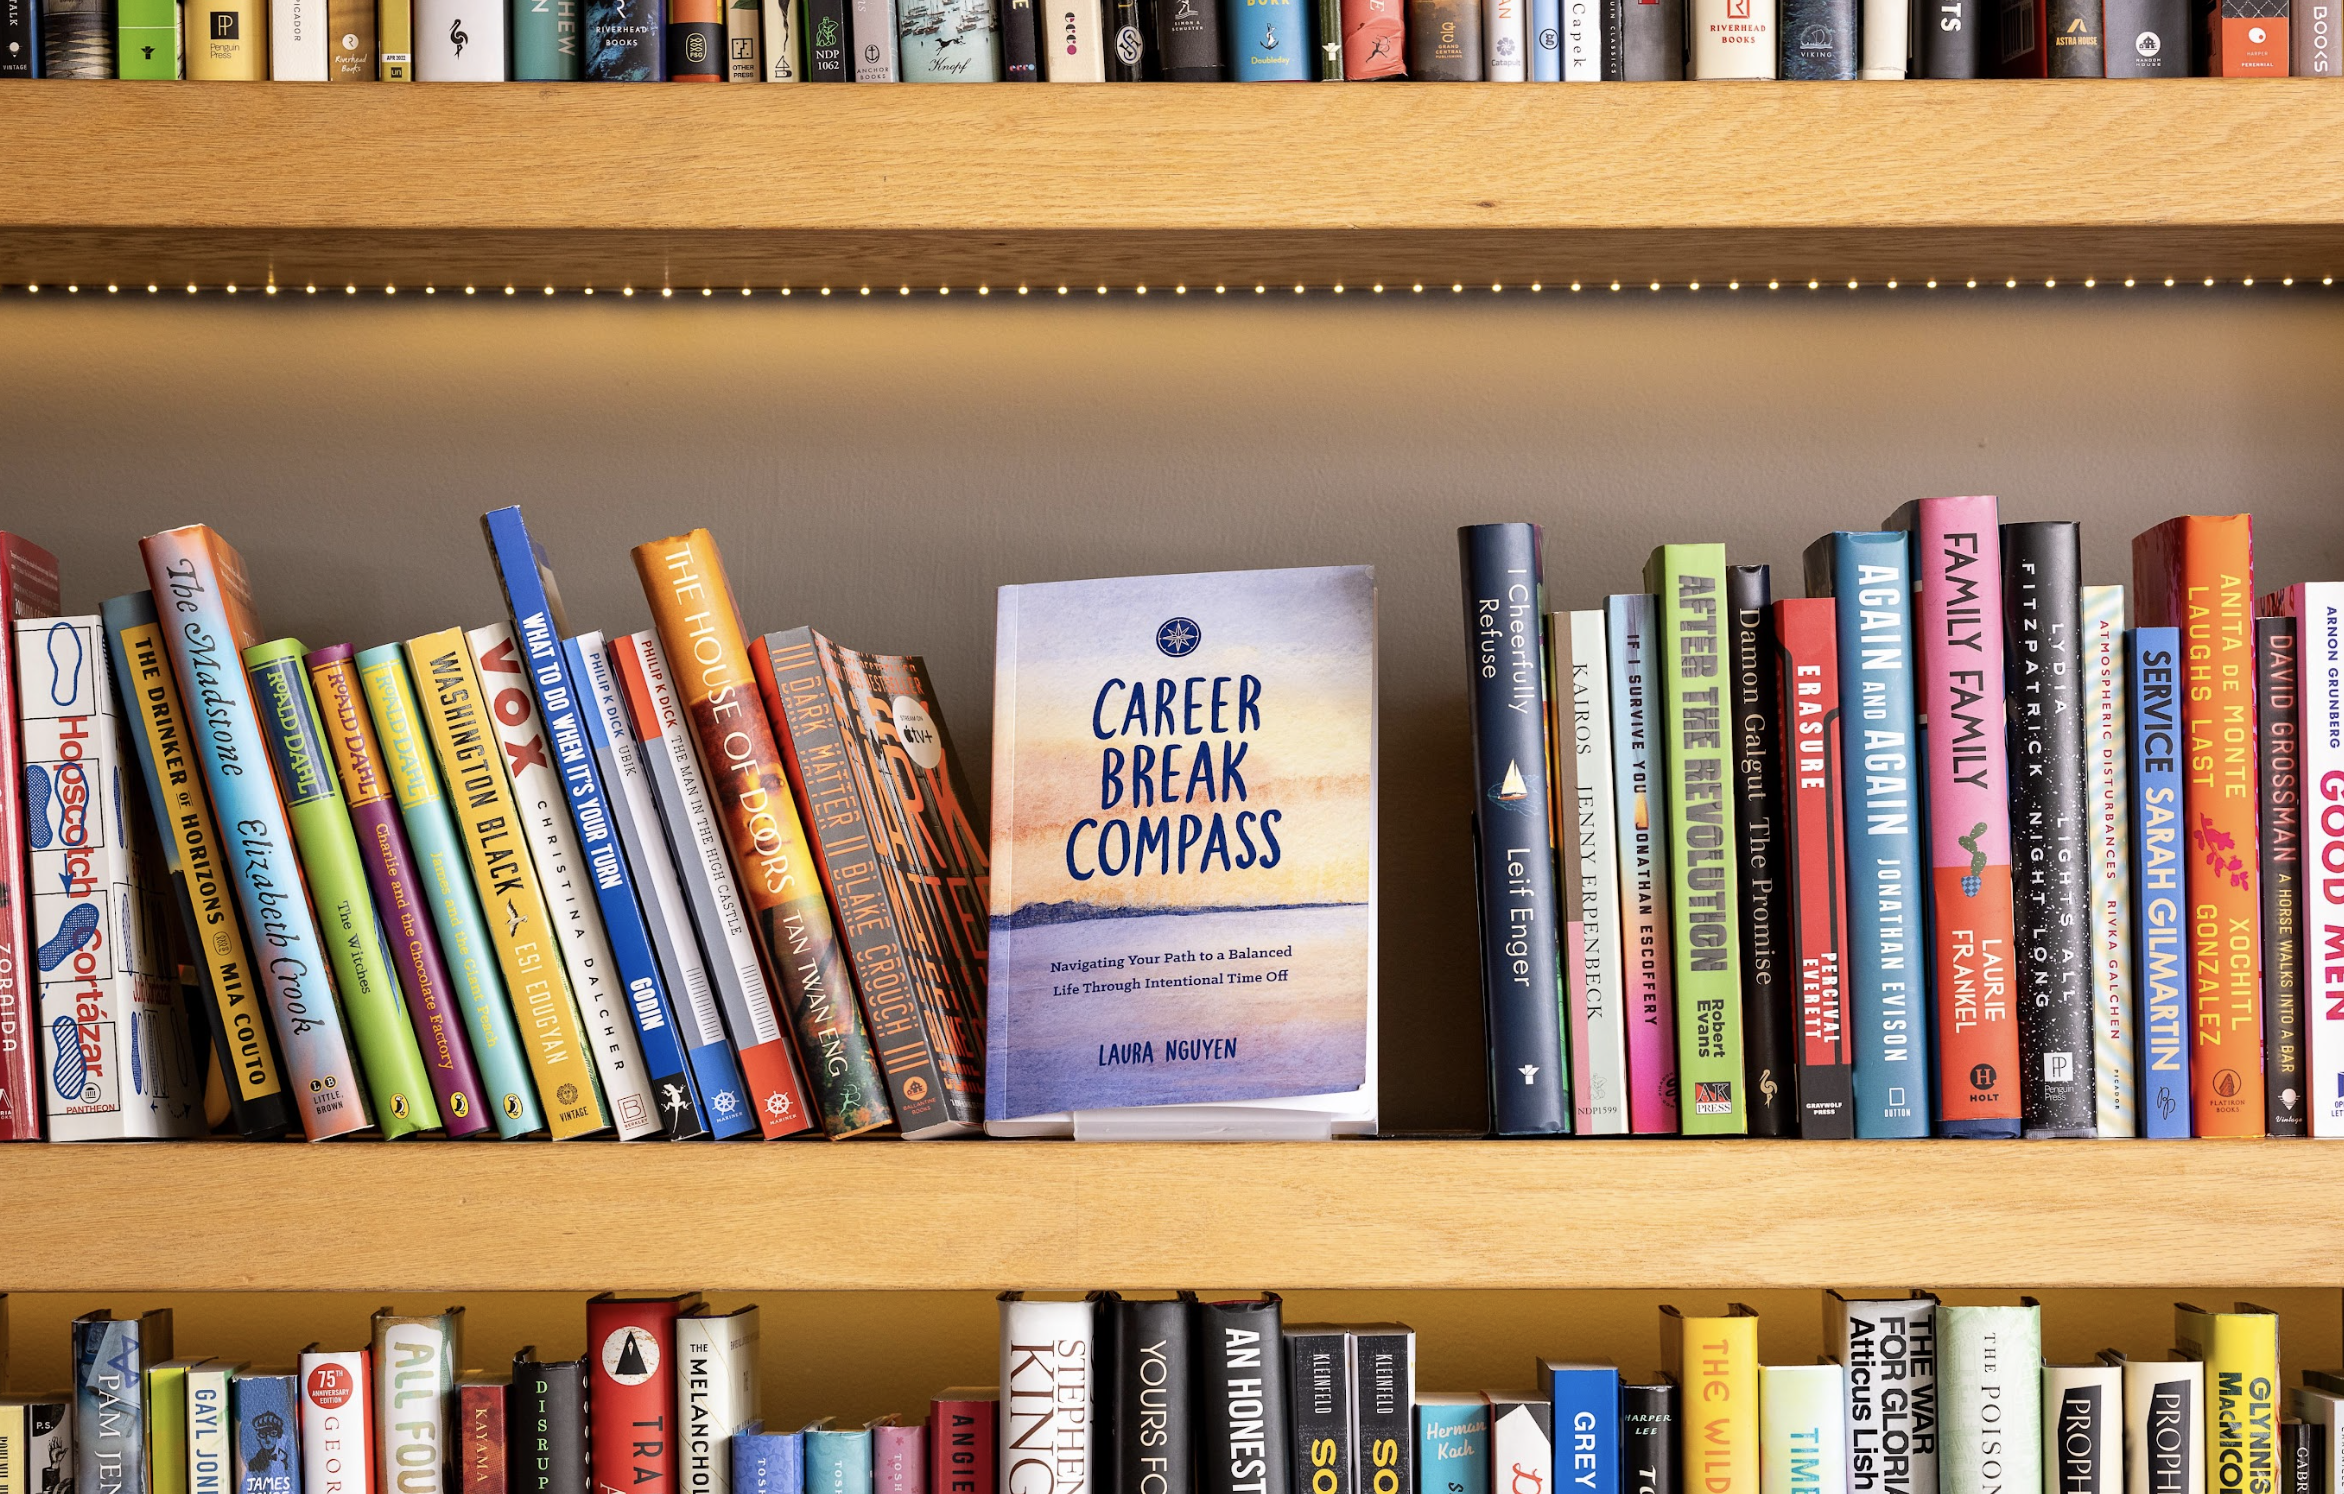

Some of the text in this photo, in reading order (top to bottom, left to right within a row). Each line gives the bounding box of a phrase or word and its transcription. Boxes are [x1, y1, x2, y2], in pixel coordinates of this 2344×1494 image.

[210, 43, 240, 54] Penguin
[606, 39, 638, 47] BOOKS
[815, 51, 840, 59] NDP
[817, 61, 840, 70] 1062
[928, 57, 971, 74] Knopf
[1251, 57, 1289, 65] Doubleday
[1710, 24, 1766, 32] RIVERHEAD
[2056, 37, 2097, 46] ASTRA HOUSE
[2313, 6, 2327, 71] BOOKS
[166, 558, 205, 612] The
[1479, 598, 1503, 679] Refuse
[1507, 585, 1535, 714] Cheerfully
[1943, 533, 1988, 789] FAMILY FAMILY
[2327, 607, 2340, 748] ARNON GRUNBERG
[184, 623, 243, 777] Madstone
[1093, 674, 1262, 740] CAREER
[2188, 586, 2214, 787] LAUGHS LAST
[2220, 574, 2246, 798] ANITA DE MONTE
[522, 611, 622, 890] WHAT TO DO WHEN IT'S YOUR TURN
[1798, 665, 1825, 789] ERASURE
[2270, 635, 2296, 861] DAVID GROSSMAN
[665, 543, 849, 1078] THE HOUSE OF DOORS TAN TWAN ENG
[1101, 740, 1248, 810] BREAK
[1678, 575, 1727, 972] AFTER THE REVOLUTION
[1739, 608, 1775, 985] Damon Galgut The Promise
[1858, 564, 1908, 1061] AGAIN AND AGAIN JONATHAN EVISON
[135, 637, 265, 1086] THE DRINKER OF HORIZONS MIA COUTO
[430, 651, 569, 1065] WASHINGTON BLACK ESI EDUGYAN
[481, 637, 624, 1071] VOX CHRISTINA DALCHER
[1066, 809, 1282, 881] COMPASS
[1572, 663, 1602, 1021] KAIROS JENNY ERPENBECK
[2100, 620, 2120, 1039] ATMOSPHERIC DISTURBANCES RIVKA GALCHEN
[2142, 651, 2180, 1070] SERVICE SARAH GILMARTIN
[237, 819, 300, 948] Elizabeth
[1505, 848, 1534, 987] Leif Enger
[338, 900, 371, 995] The Witches
[1051, 957, 1125, 974] Navigating
[1128, 955, 1160, 967] Your
[1164, 951, 1196, 963] Path
[1199, 951, 1213, 962] to
[1229, 946, 1292, 959] Balanced
[1053, 970, 1289, 997] Life Through Intentional Time Off
[1951, 930, 1977, 1033] FRANKEL
[1982, 939, 2005, 1021] LAURIE
[2197, 904, 2220, 1045] GONZALEZ
[2229, 918, 2252, 1030] XOCHITL
[270, 958, 324, 1036] Crook
[630, 976, 665, 1031] GODIN
[1697, 1000, 1710, 1058] Evans
[1711, 999, 1725, 1058] Robert
[1803, 959, 1821, 1038] EVERETT
[1821, 952, 1839, 1043] PERCIVAL
[1099, 1038, 1238, 1067] LAURA NGUYEN
[559, 1107, 589, 1123] VINTAGE
[1697, 1103, 1731, 1113] PRESS
[1700, 1083, 1728, 1101] AK
[1884, 1108, 1911, 1116] DUTTON
[394, 1341, 434, 1409] ALL
[1880, 1317, 1905, 1380] FOR
[1908, 1315, 1935, 1455] THE WAR
[98, 1375, 120, 1438] PAM
[195, 1389, 217, 1439] GAYL
[312, 1389, 350, 1397] ANNIVERSARY
[1009, 1340, 1055, 1494] KING
[1140, 1340, 1167, 1447] YOURS
[1226, 1328, 1266, 1494] AN HONEST
[1426, 1421, 1487, 1441] Herman
[1625, 1414, 1671, 1422] HARPER
[1702, 1339, 1731, 1494] THE WILD
[1849, 1317, 1879, 1490] Atticus Lish
[475, 1409, 488, 1482] KAYAMA
[952, 1415, 974, 1492] ANGIE
[1438, 1439, 1474, 1461] Koch
[1573, 1412, 1596, 1488] GREY
[2249, 1377, 2271, 1494] GLYNNIS
[247, 1477, 290, 1490] JAMES
